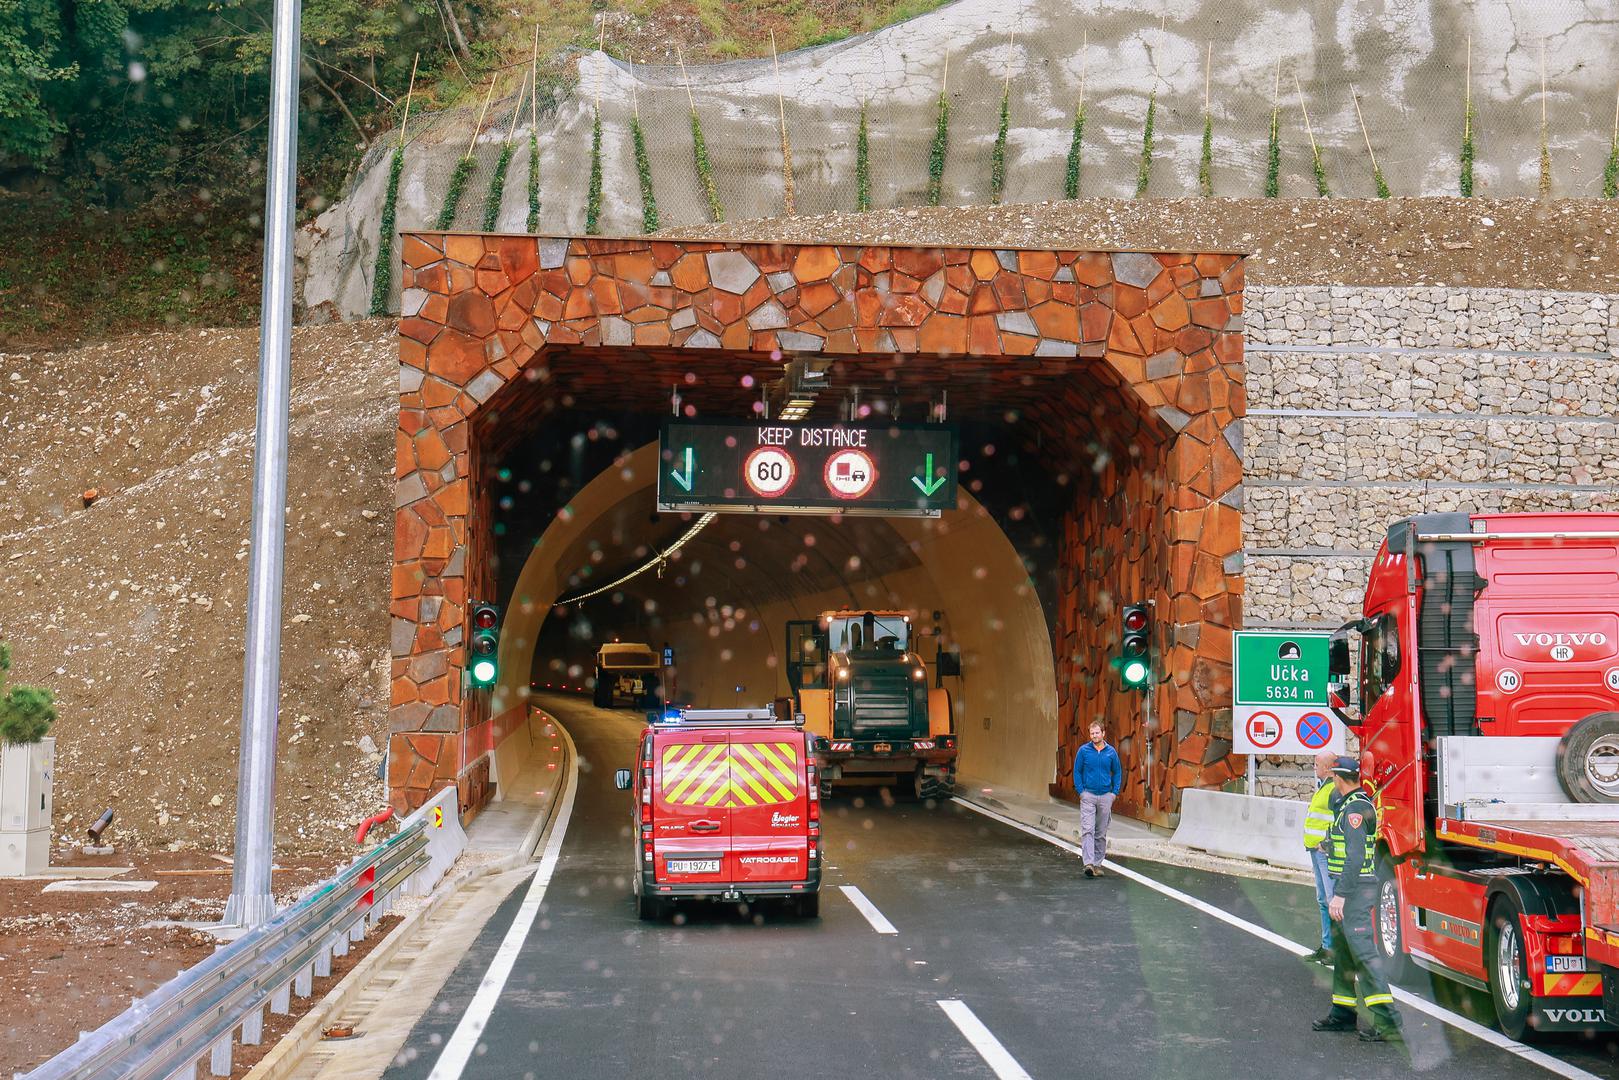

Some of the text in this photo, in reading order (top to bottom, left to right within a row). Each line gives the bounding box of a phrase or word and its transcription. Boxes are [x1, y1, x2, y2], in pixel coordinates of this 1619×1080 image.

[758, 427, 867, 447] KEEP DISTANCE
[757, 462, 783, 481] 60
[1513, 632, 1607, 646] VOLVO
[1556, 648, 1569, 659] HR
[1271, 664, 1309, 681] Učka
[1503, 675, 1516, 686] 70
[1611, 674, 1619, 685] 8
[1266, 686, 1314, 699] 5634 m
[673, 862, 683, 871] PU
[739, 856, 799, 864] VATROGASCI
[1554, 957, 1570, 970] PU
